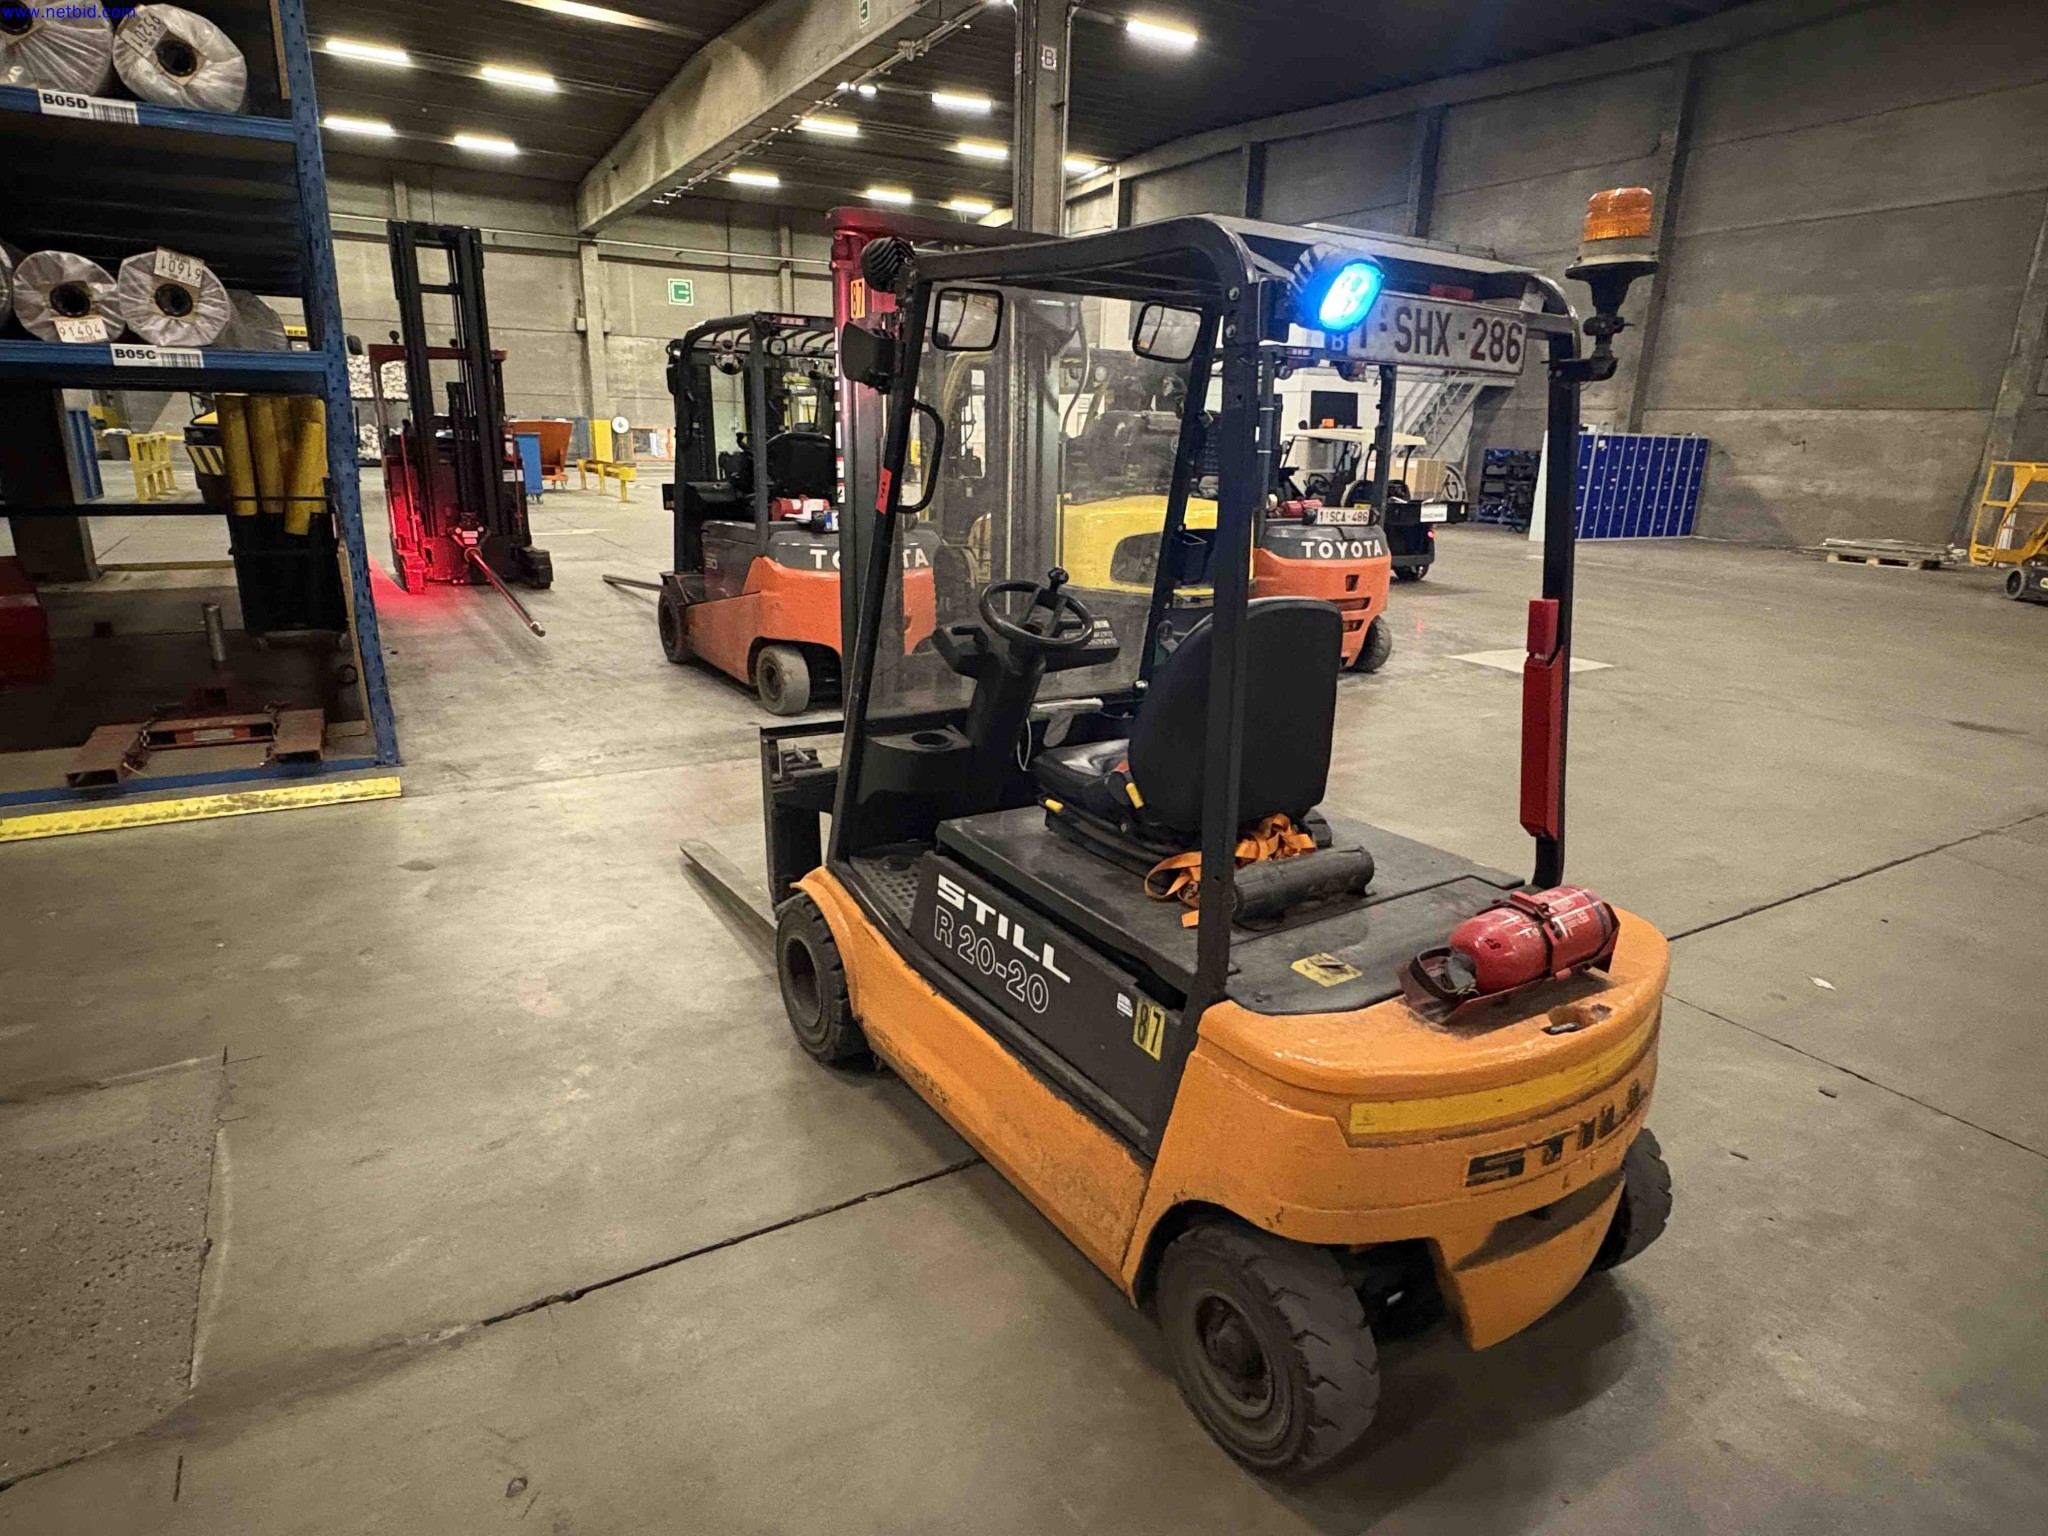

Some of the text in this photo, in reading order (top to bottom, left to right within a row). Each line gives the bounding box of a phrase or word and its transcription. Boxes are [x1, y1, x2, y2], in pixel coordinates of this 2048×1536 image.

[1045, 50, 1054, 66] B
[42, 93, 88, 109] B05D
[852, 282, 863, 316] 87
[59, 323, 102, 337] 91404
[115, 348, 156, 360] B05C
[1301, 540, 1383, 559] TOYOTA
[937, 874, 1071, 984] STILL
[934, 905, 1049, 1014] R 20-20
[1138, 1003, 1161, 1053] 87
